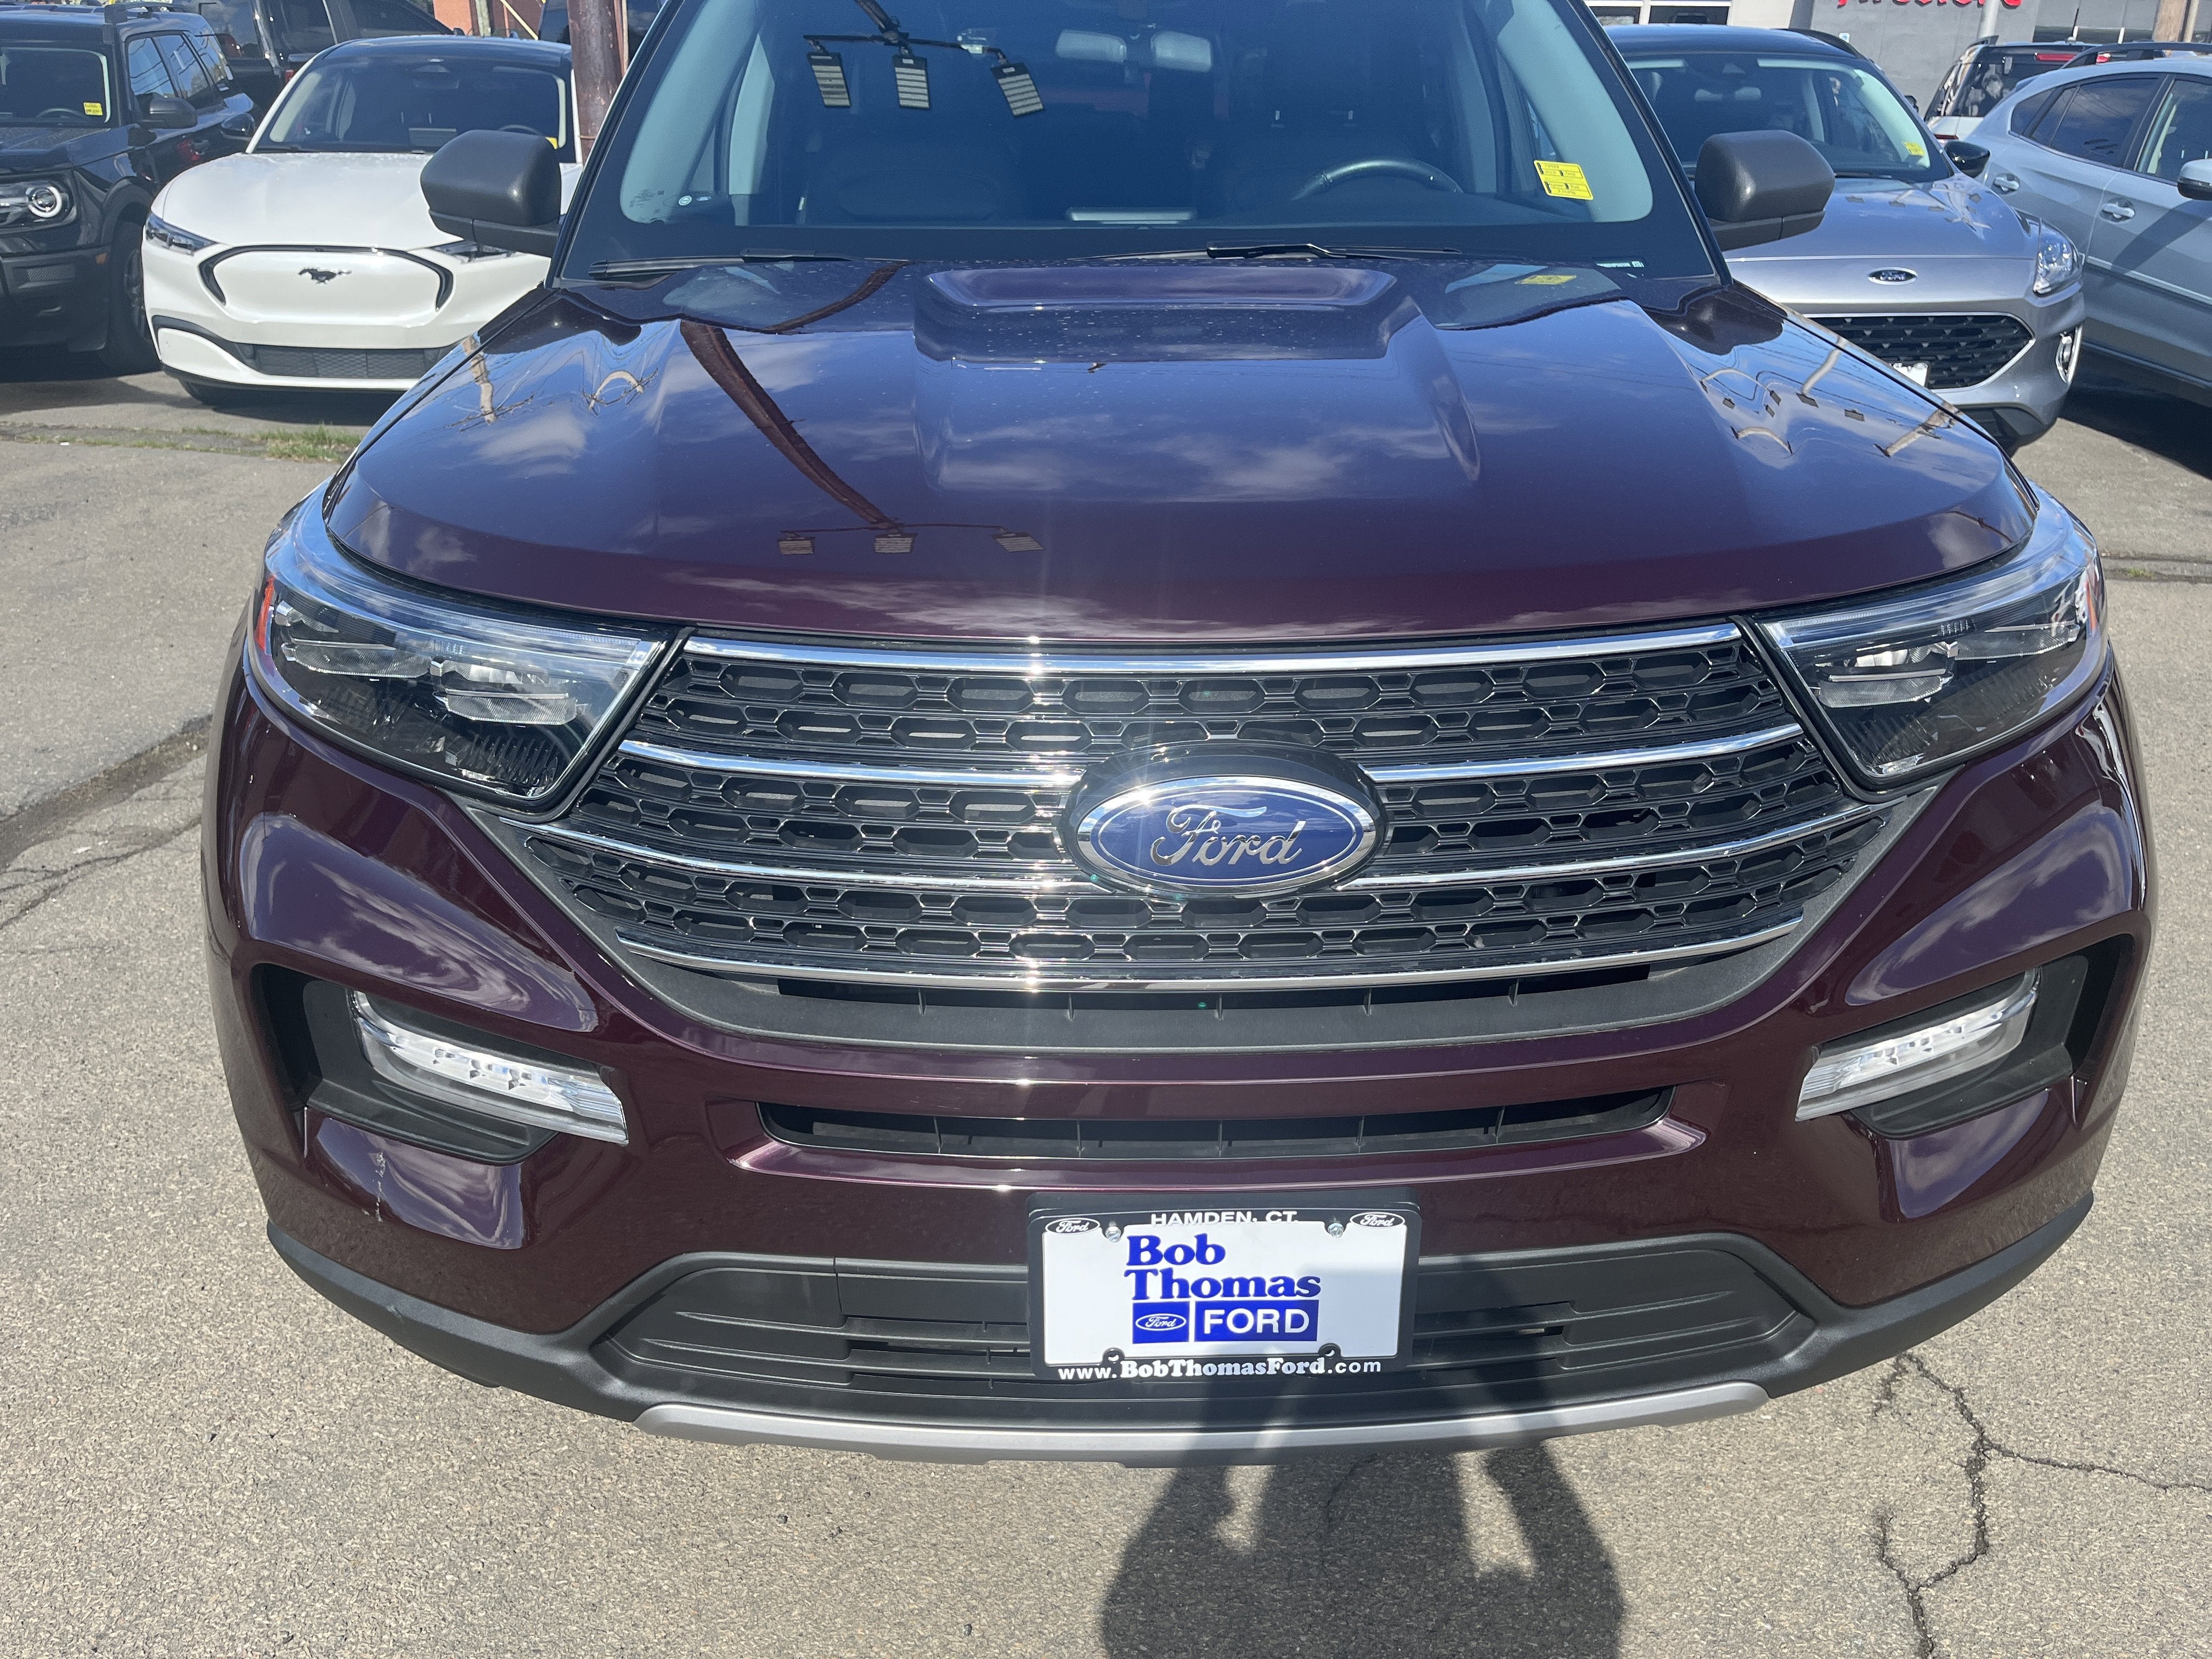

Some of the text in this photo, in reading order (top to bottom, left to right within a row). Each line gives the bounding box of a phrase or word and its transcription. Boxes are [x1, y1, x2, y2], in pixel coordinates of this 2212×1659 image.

[1150, 804, 1307, 866] Ford
[1056, 1220, 1090, 1233] Ford
[1150, 1210, 1299, 1226] HAMDEN, CT.
[1359, 1214, 1395, 1227] Ford
[1126, 1233, 1226, 1266] Bob
[1124, 1267, 1321, 1300] Thomas
[1145, 1308, 1310, 1334] Ford FORD
[1058, 1357, 1382, 1380] www.BobThomasFord.com
